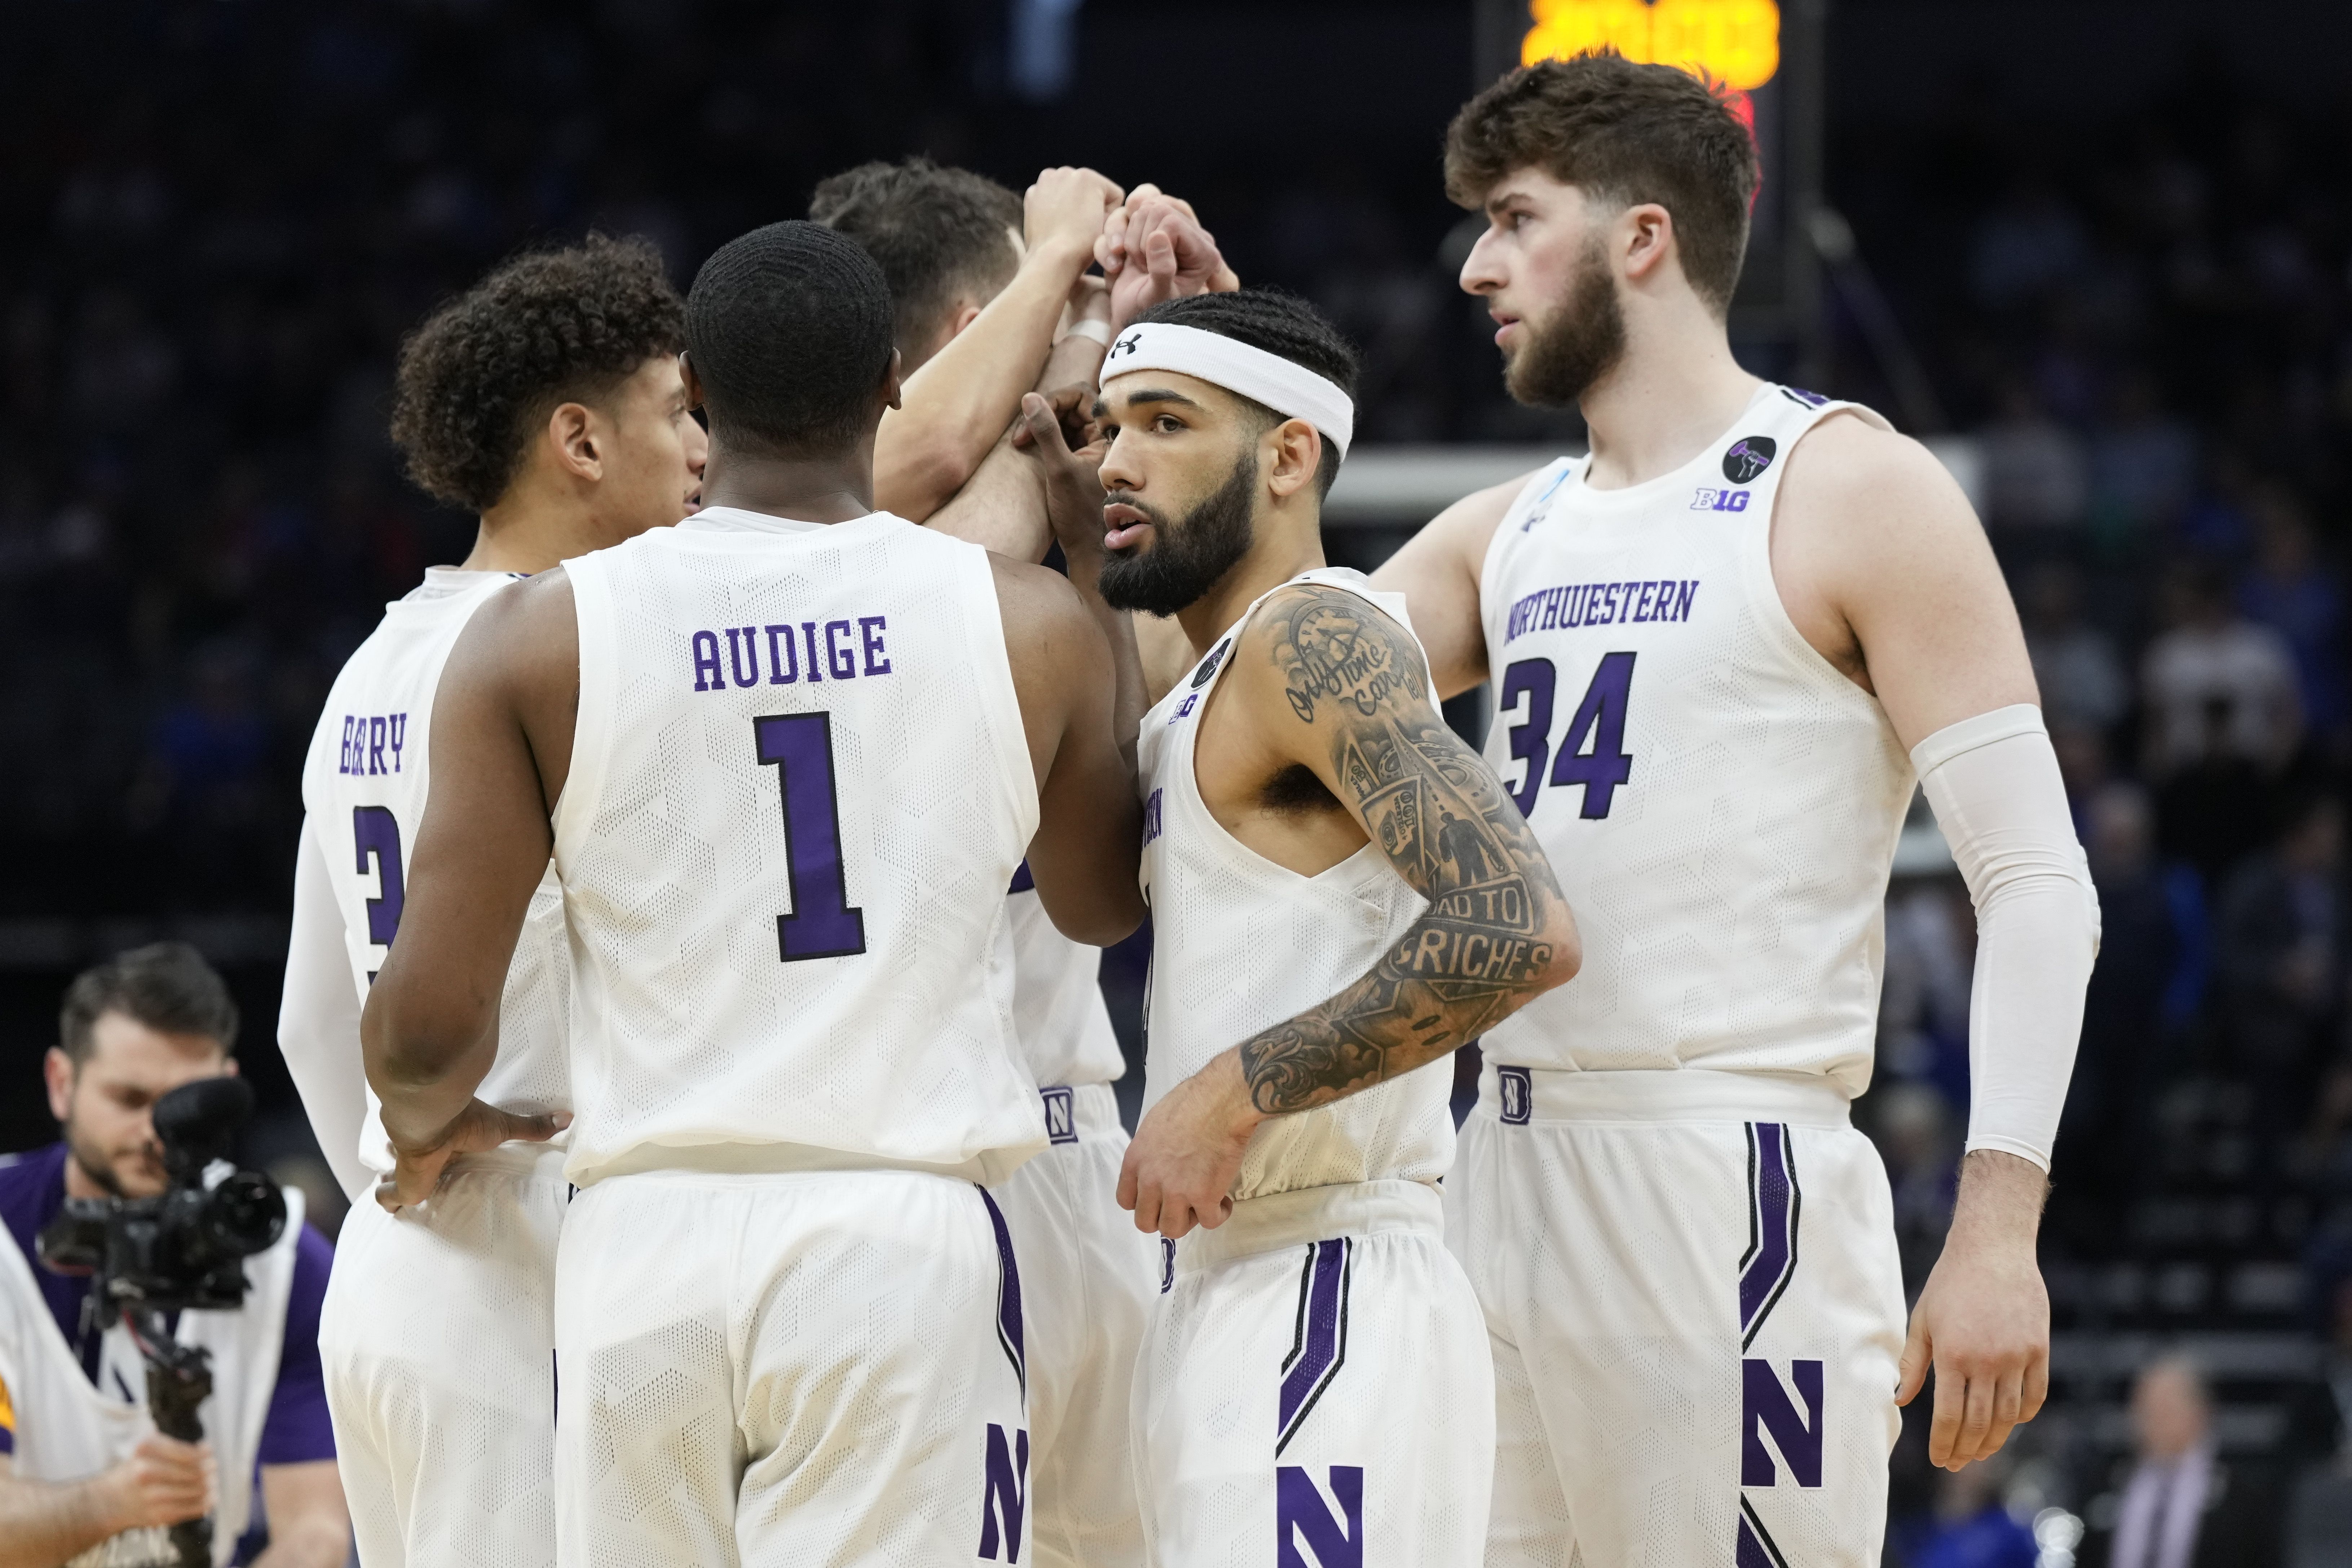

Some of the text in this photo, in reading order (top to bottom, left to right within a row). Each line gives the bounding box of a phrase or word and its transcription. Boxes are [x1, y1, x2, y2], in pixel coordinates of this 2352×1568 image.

[692, 615, 892, 691] AUDIGE
[1504, 580, 1699, 646] NORTHWESTERN
[1500, 651, 1637, 820] 34
[753, 711, 866, 962] 1
[1478, 887, 1521, 924] TO
[1412, 929, 1552, 981] RICHES
[1049, 1096, 1068, 1135] N
[1741, 1359, 1823, 1487] N
[978, 1423, 1029, 1564] N
[1276, 1466, 1363, 1568] N
